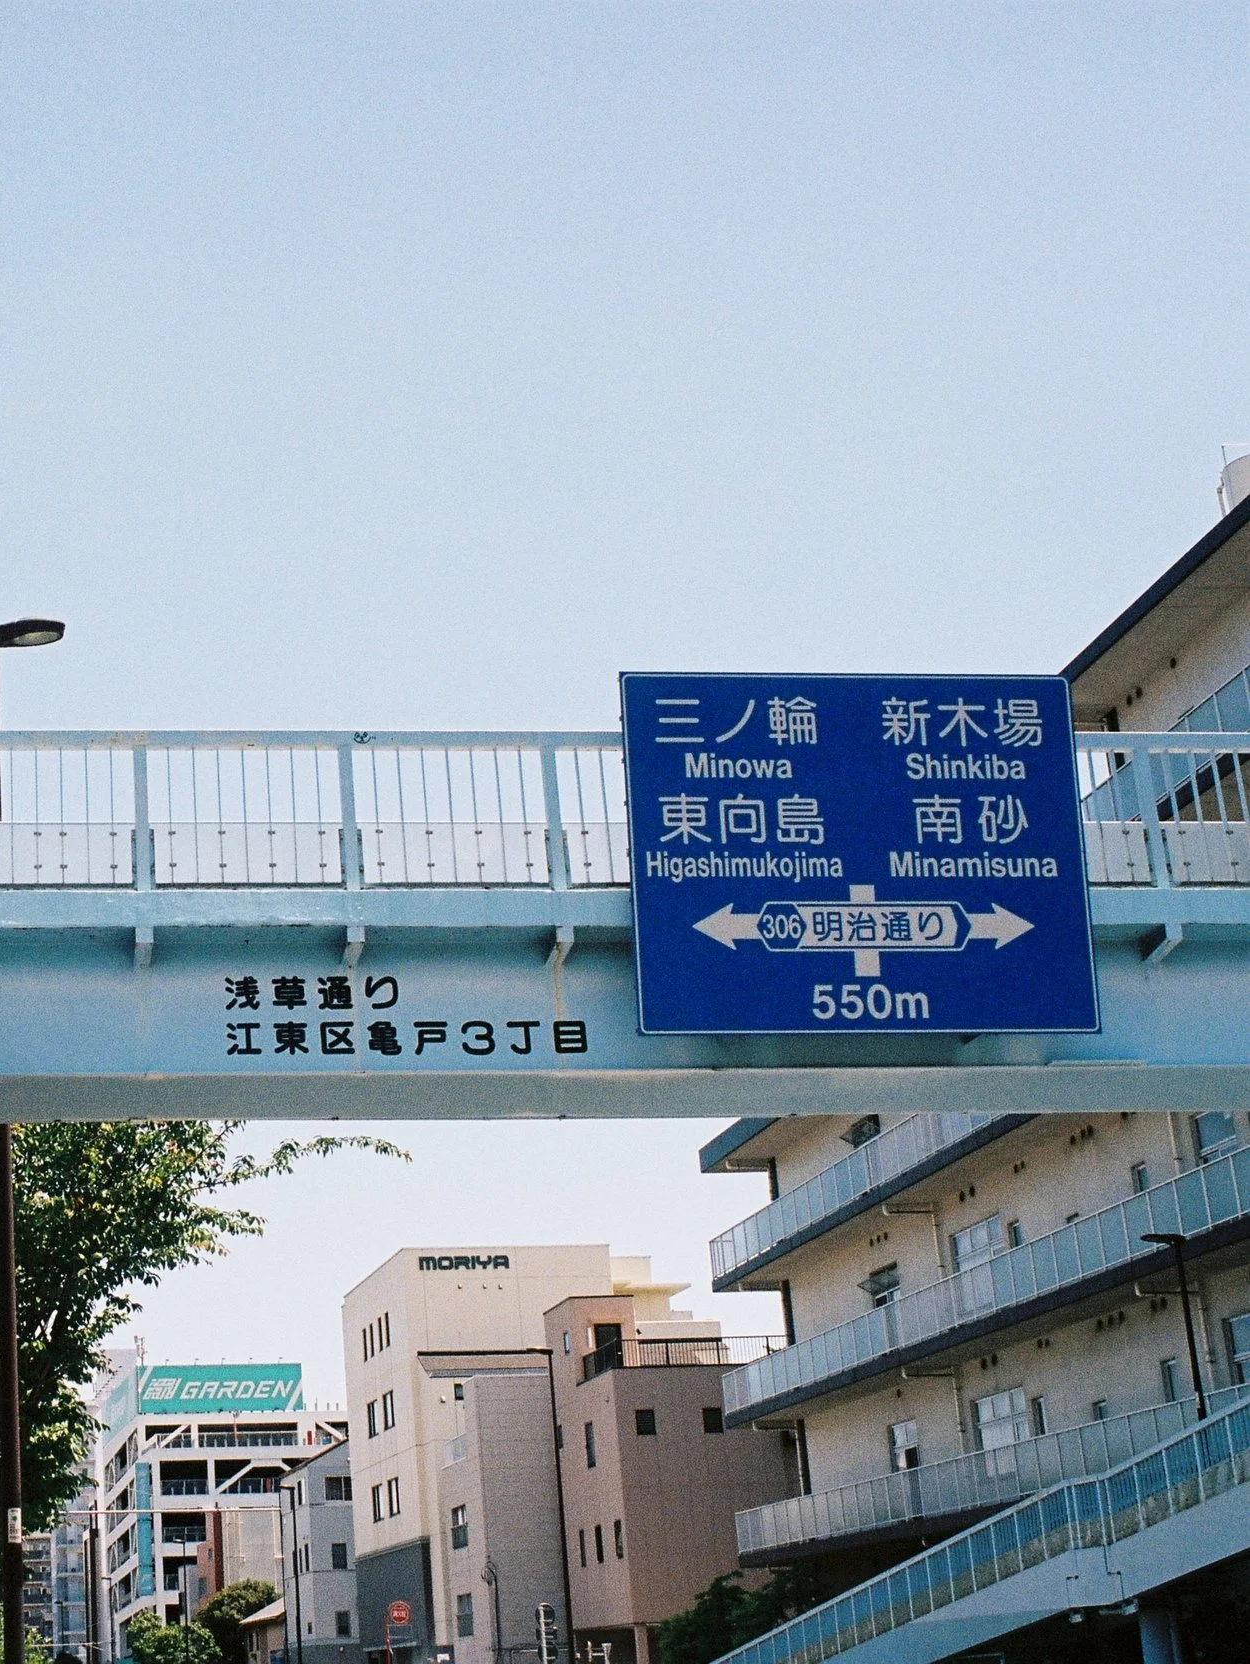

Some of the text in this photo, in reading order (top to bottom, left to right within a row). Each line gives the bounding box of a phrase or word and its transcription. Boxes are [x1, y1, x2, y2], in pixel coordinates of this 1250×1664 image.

[654, 695, 818, 746] 三ノ輪
[881, 696, 1043, 747] 新木場
[684, 752, 793, 779] Minowa
[906, 752, 1027, 781] Shinkiba
[658, 793, 825, 845] 東向島
[912, 794, 1029, 844] 南砂
[646, 851, 844, 883] Higashimukojima
[889, 851, 1059, 878] Minamisuna
[762, 914, 802, 940] 306
[812, 911, 944, 942] 明治通り
[224, 974, 400, 1011] 浅草通り
[812, 983, 930, 1020] 550m
[179, 1379, 294, 1400] GARDEN
